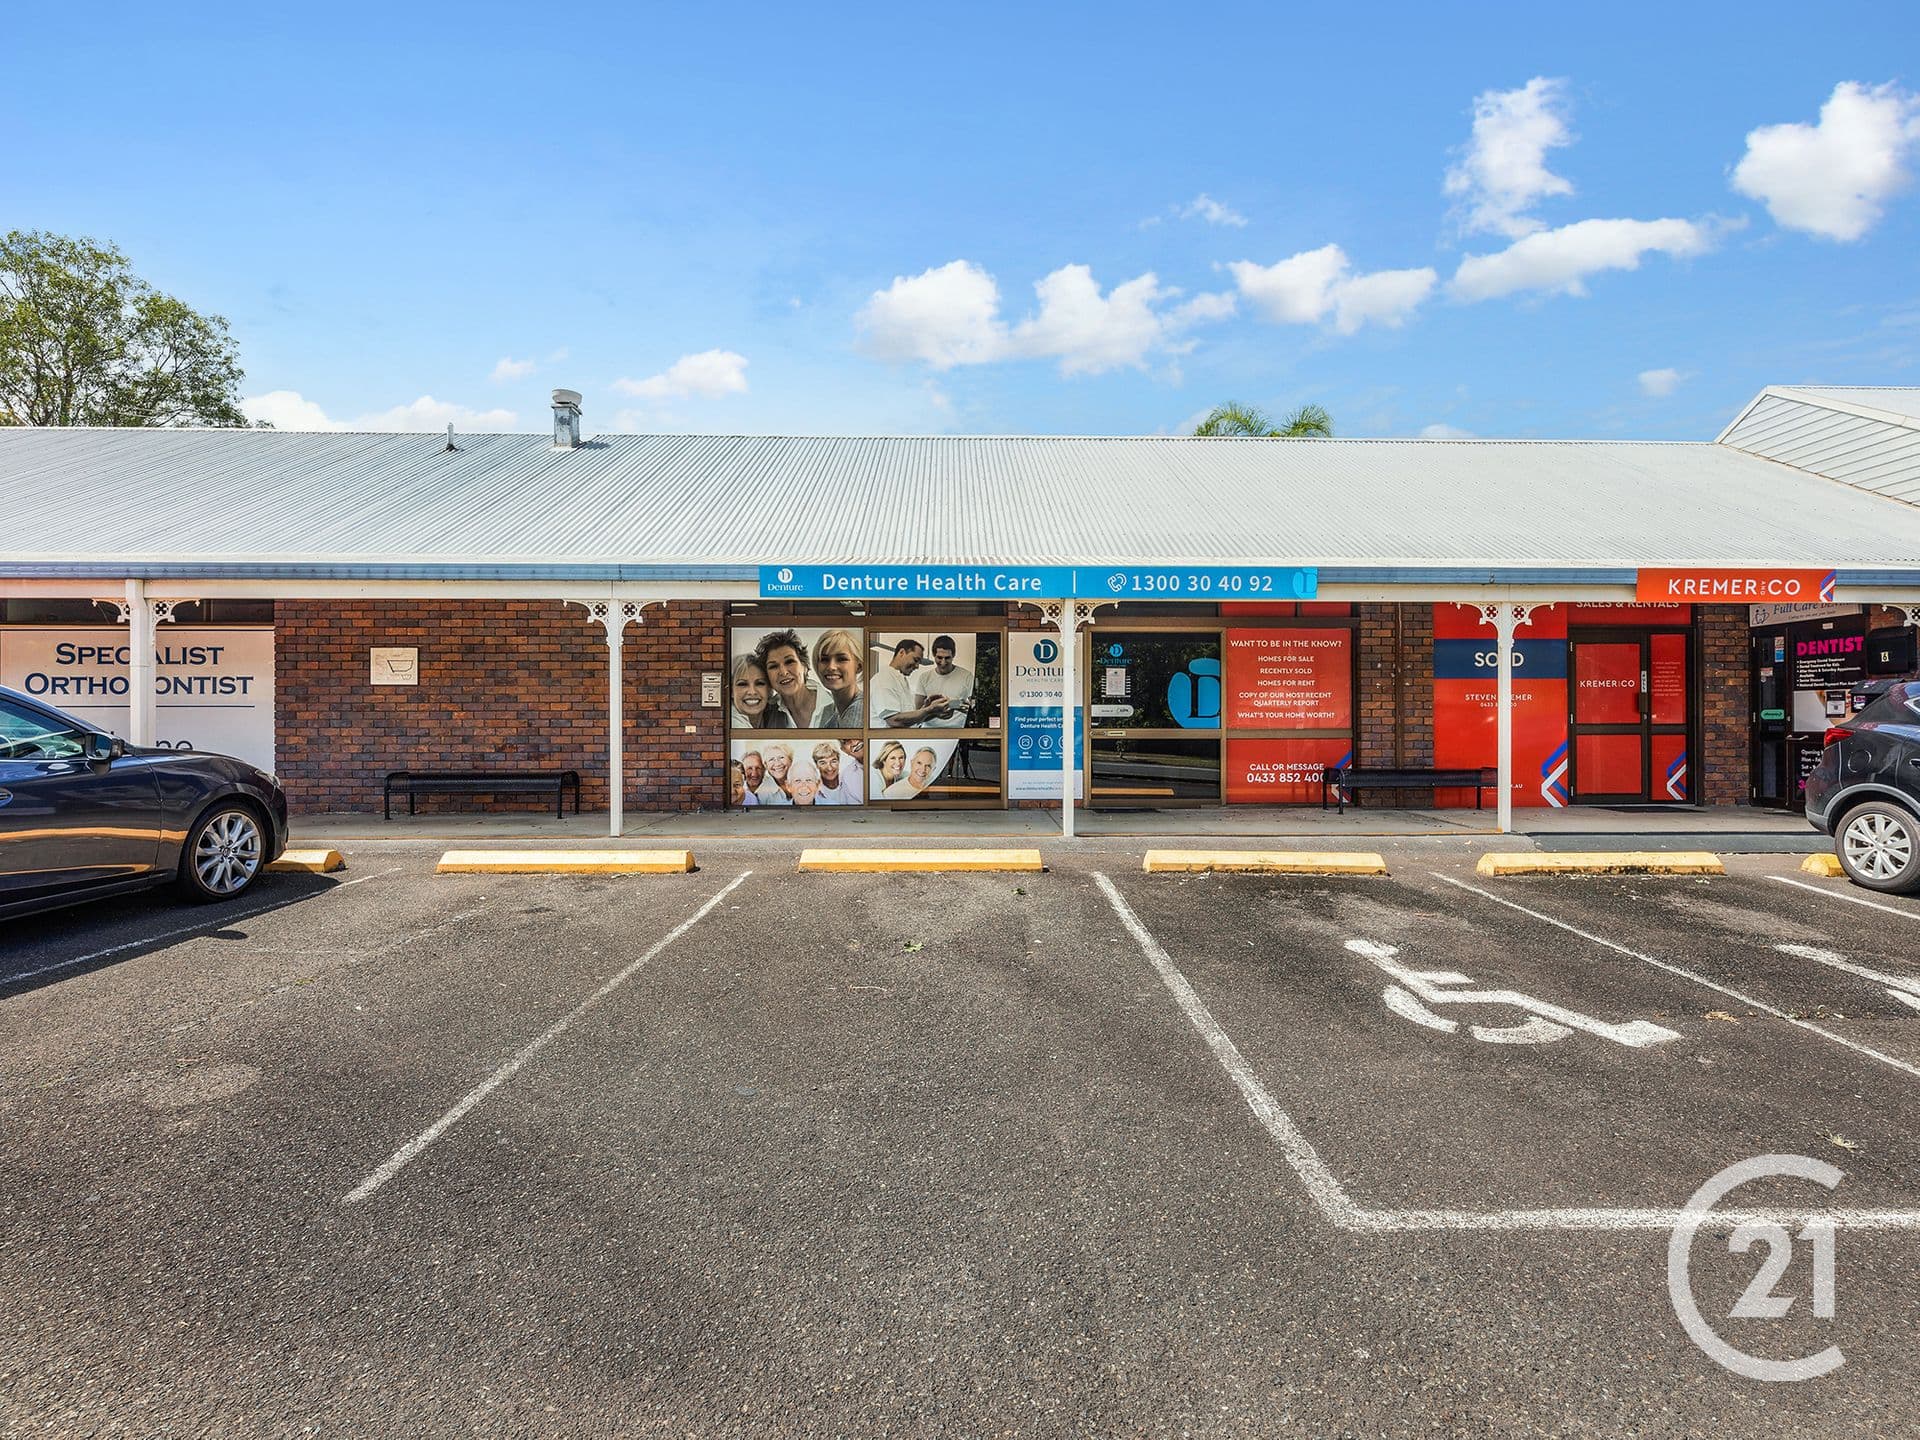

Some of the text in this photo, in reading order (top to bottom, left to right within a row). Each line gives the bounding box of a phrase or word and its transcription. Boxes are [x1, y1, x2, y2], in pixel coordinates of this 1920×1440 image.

[822, 573, 1042, 591] Denture Health Care
[1131, 575, 1273, 591] 1300 30 40 92
[767, 583, 804, 592] Denture
[1668, 579, 1757, 596] KREMER
[1767, 579, 1800, 595] CO
[1793, 603, 1818, 613] Care
[1231, 640, 1342, 648] WANT TO BE IN THE KNOW?
[1796, 636, 1864, 656] DENTIST
[56, 643, 224, 665] SPECLIST
[1100, 657, 1133, 665] Denture
[1474, 652, 1524, 667] SOD
[1015, 666, 1076, 677] Dentu
[25, 672, 254, 695] ORTHOONTIST
[1580, 680, 1617, 688] KREMER
[708, 692, 714, 701] 5
[1465, 693, 1532, 701] STEVEN EMER
[1287, 763, 1324, 771] MESSAGE
[1247, 773, 1275, 782] 0433
[1279, 773, 1300, 782] 852
